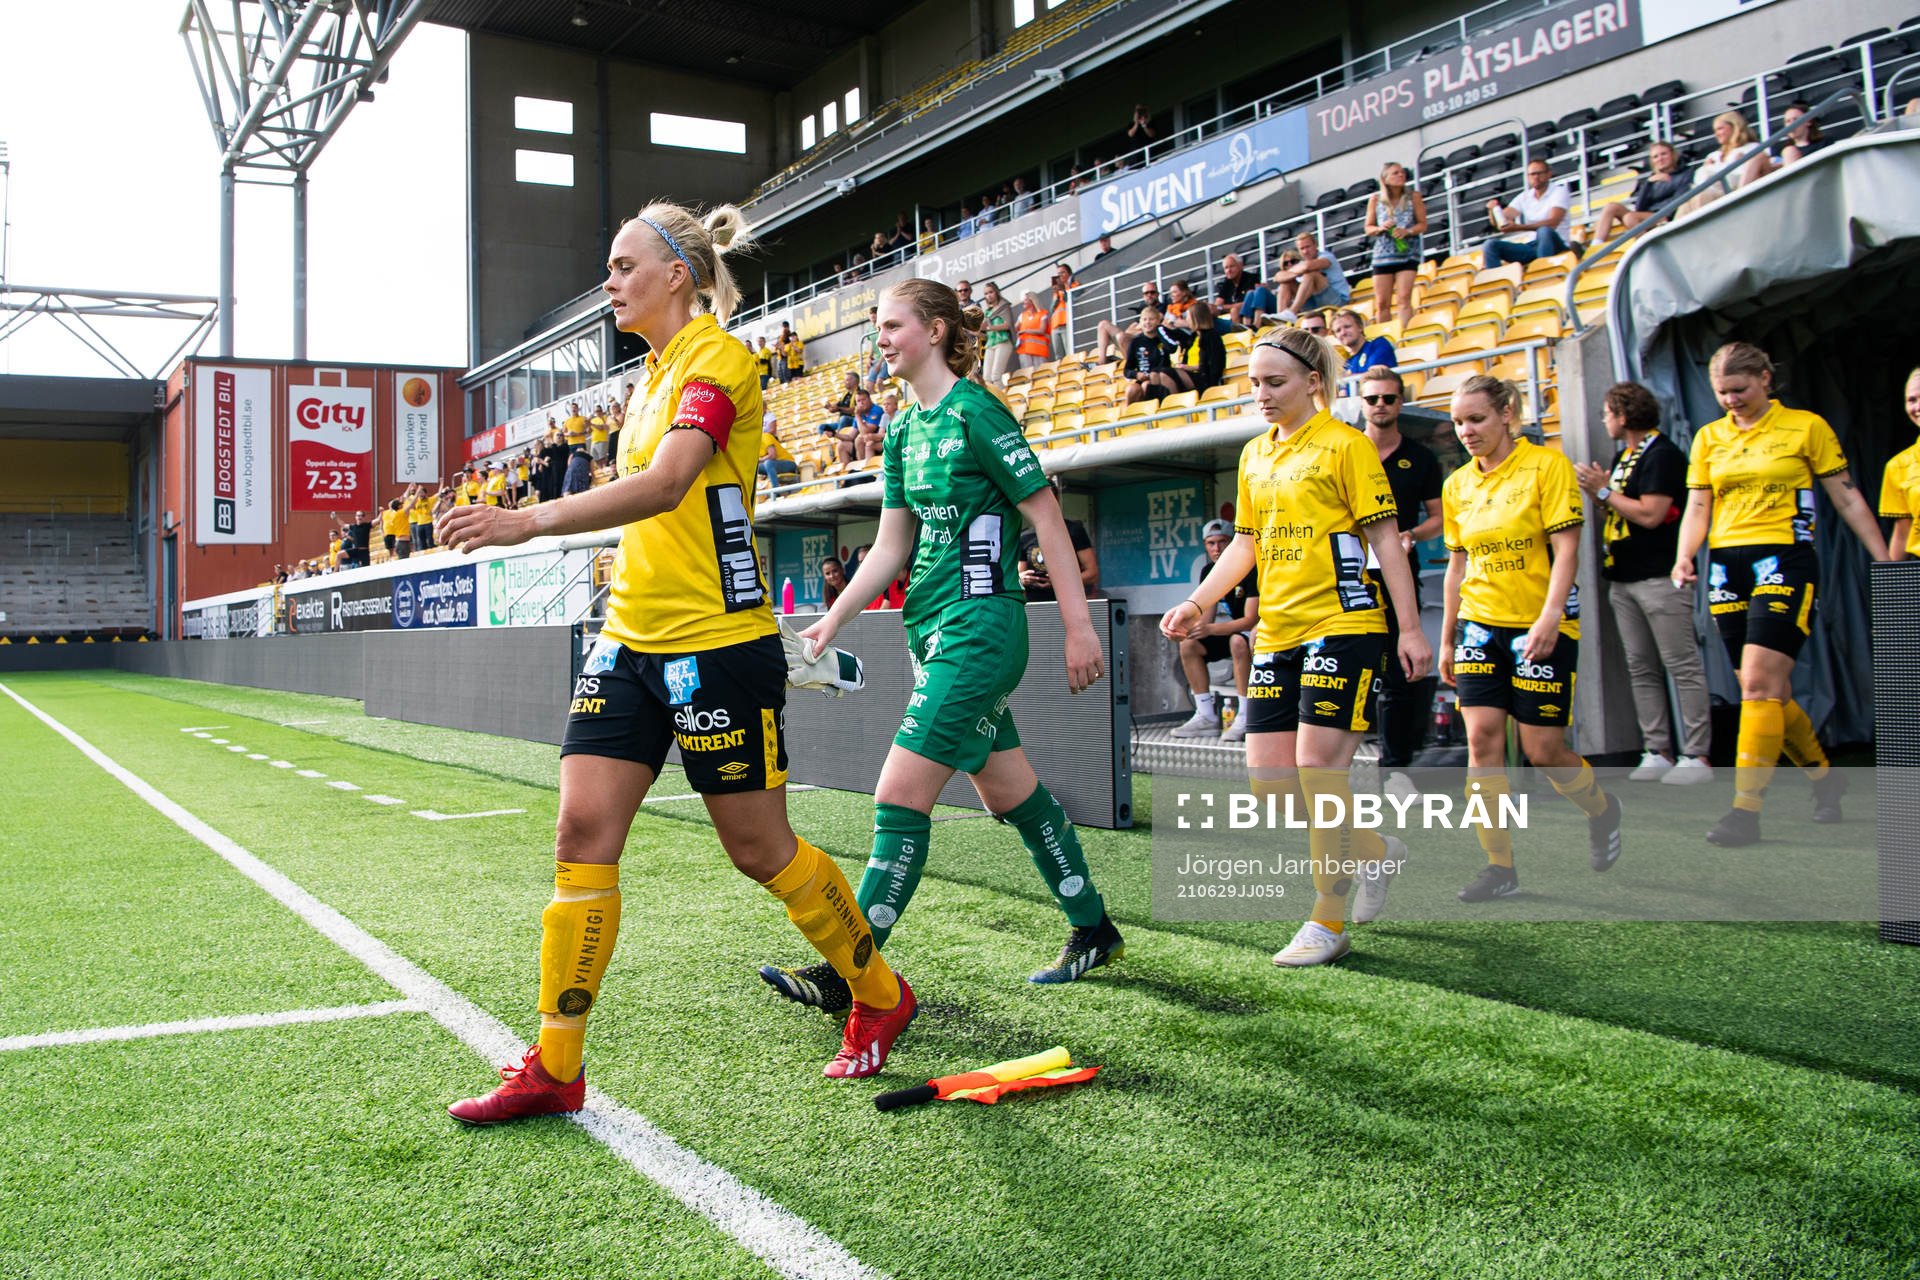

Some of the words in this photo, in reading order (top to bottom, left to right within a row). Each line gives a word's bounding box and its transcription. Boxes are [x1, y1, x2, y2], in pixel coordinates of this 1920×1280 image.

[1317, 79, 1413, 137] TOARPS
[1423, 0, 1629, 99] PLÅTSLAGERI
[1101, 160, 1207, 231] SILVENT
[946, 213, 1077, 276] FASTIGHETSSERVICE
[219, 377, 231, 403] BIL
[296, 398, 365, 430] City
[219, 415, 231, 493] BOGSTEDT
[244, 398, 253, 508] www.bogstedtbil.se
[405, 412, 415, 476] Sparbanken
[305, 471, 358, 490] 7-23
[1147, 488, 1196, 520] EFF
[1148, 517, 1203, 550] EKT
[296, 598, 324, 620] exakta
[723, 564, 735, 603] interiör
[667, 660, 691, 673] EFF
[674, 705, 731, 732] ellos
[885, 837, 915, 905] VINNERGI
[1040, 820, 1072, 877] VINNERGI
[820, 880, 862, 943] VINNERGI
[574, 908, 604, 985] VINNERGI
